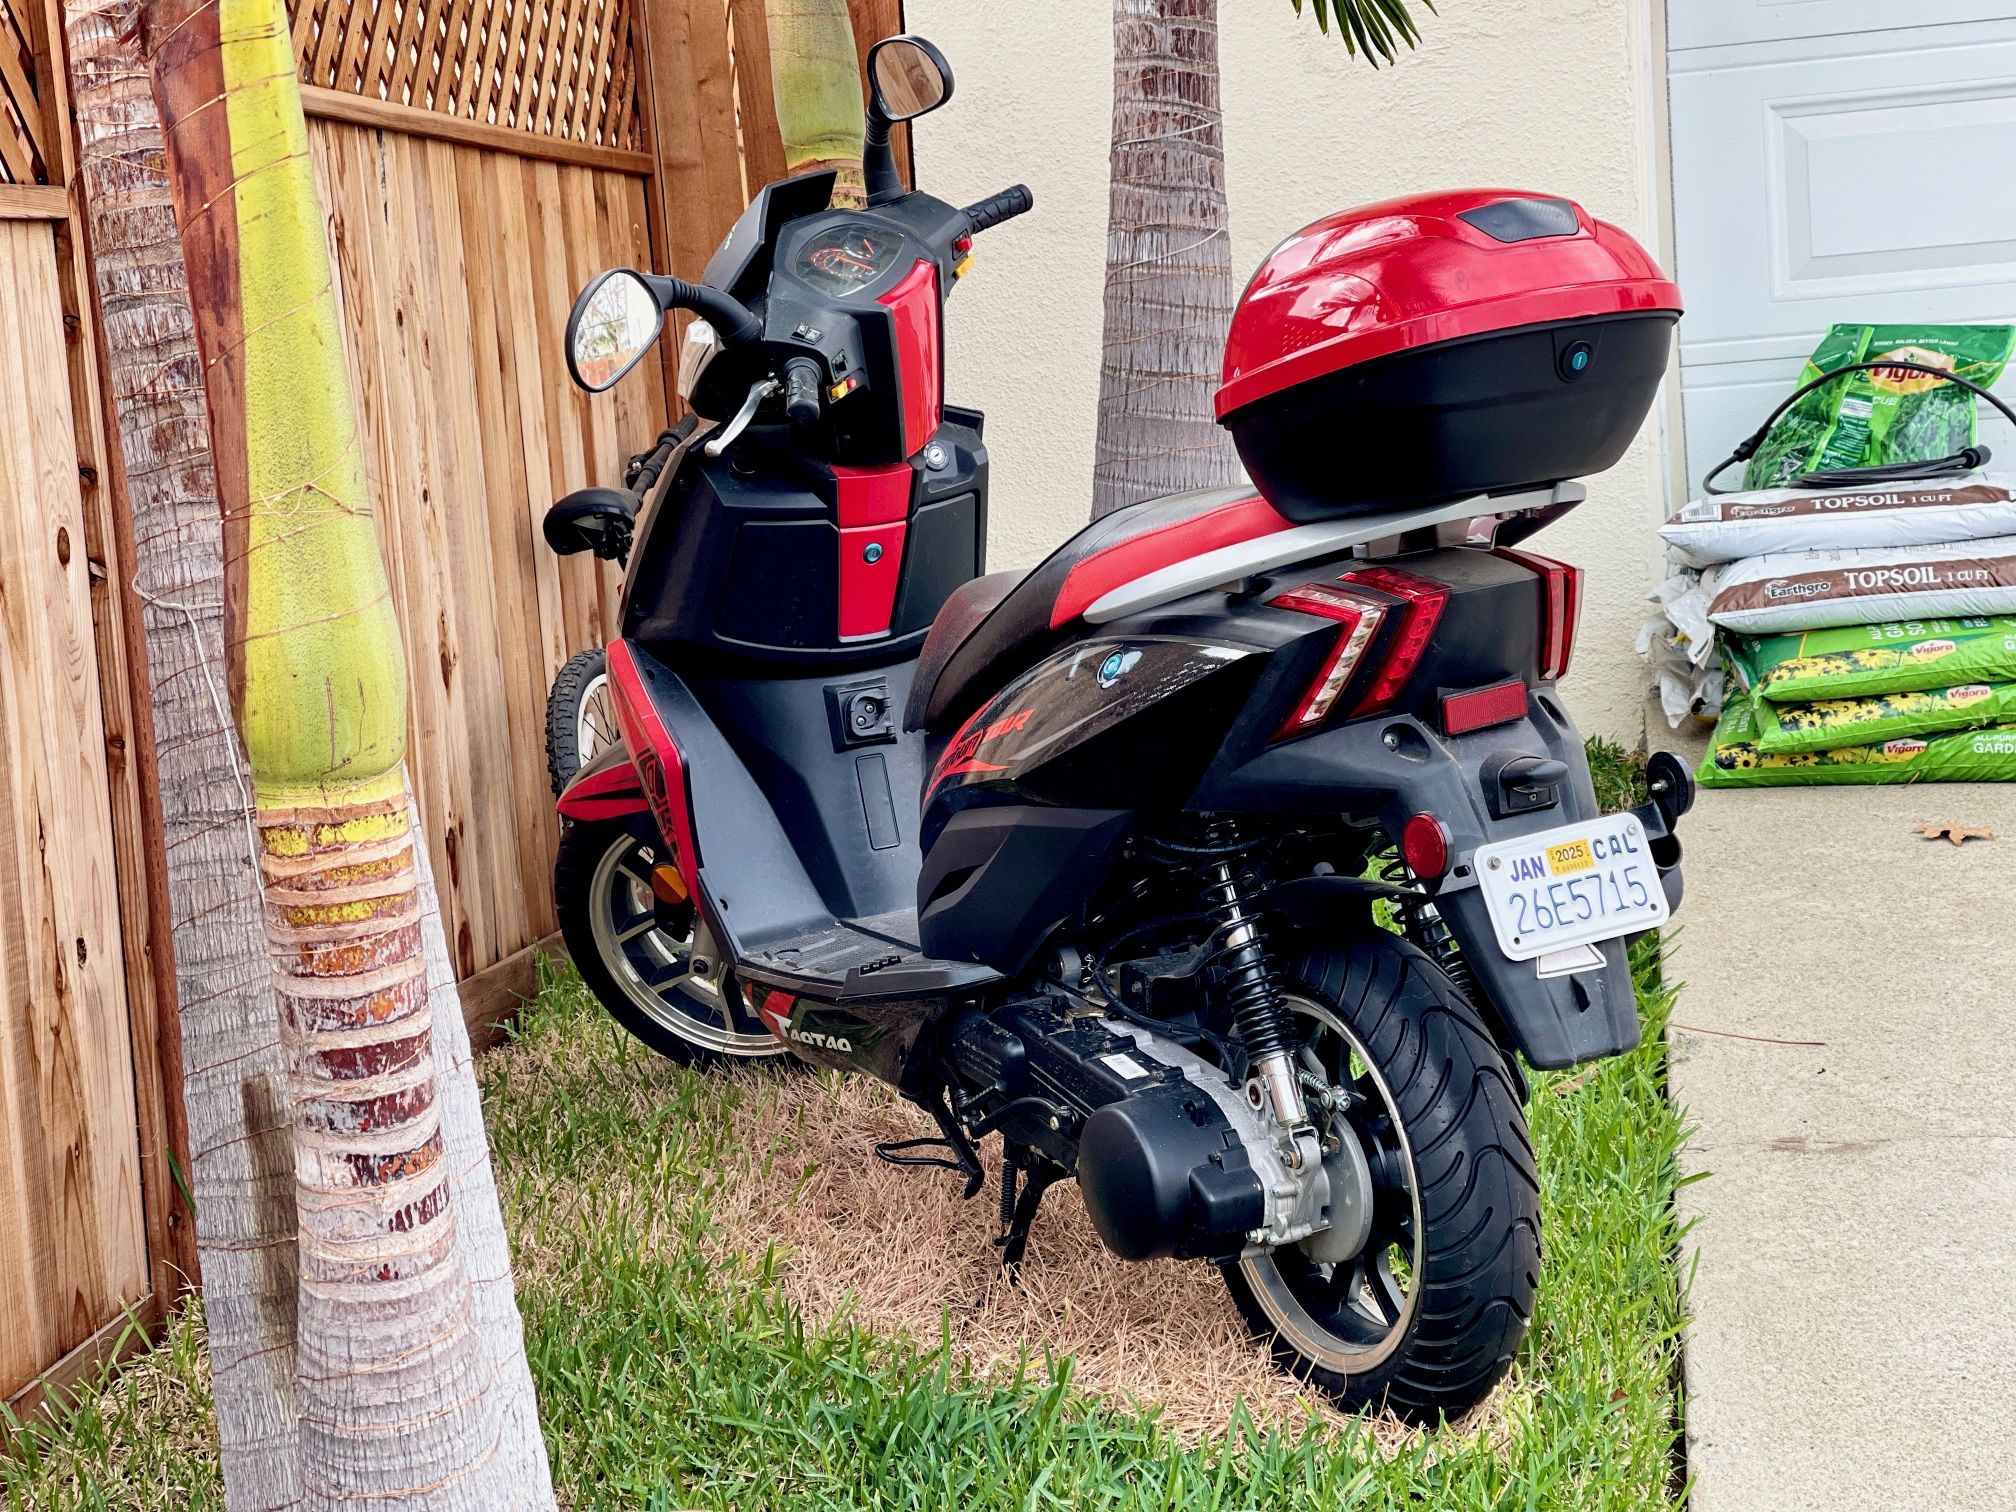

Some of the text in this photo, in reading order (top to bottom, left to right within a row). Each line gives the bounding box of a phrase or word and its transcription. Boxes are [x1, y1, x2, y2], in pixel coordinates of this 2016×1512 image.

[1811, 493, 1905, 510] TOPSOIL
[1920, 495, 1936, 503] CU
[1938, 494, 1953, 502] FT
[1769, 581, 1832, 598] Earthgro
[1844, 566, 1942, 589] TOPSOIL
[1957, 570, 1974, 581] CU
[1975, 569, 1989, 580] FT
[1914, 642, 1954, 655] Vigoro
[1949, 687, 1989, 699] Vigoro
[1887, 743, 1926, 755] Vigoro
[1973, 742, 2016, 754] GARD
[1510, 855, 1547, 883] JAN
[1555, 844, 1584, 863] 2025
[1592, 832, 1638, 860] CAL
[1508, 865, 1649, 935] 26E5715
